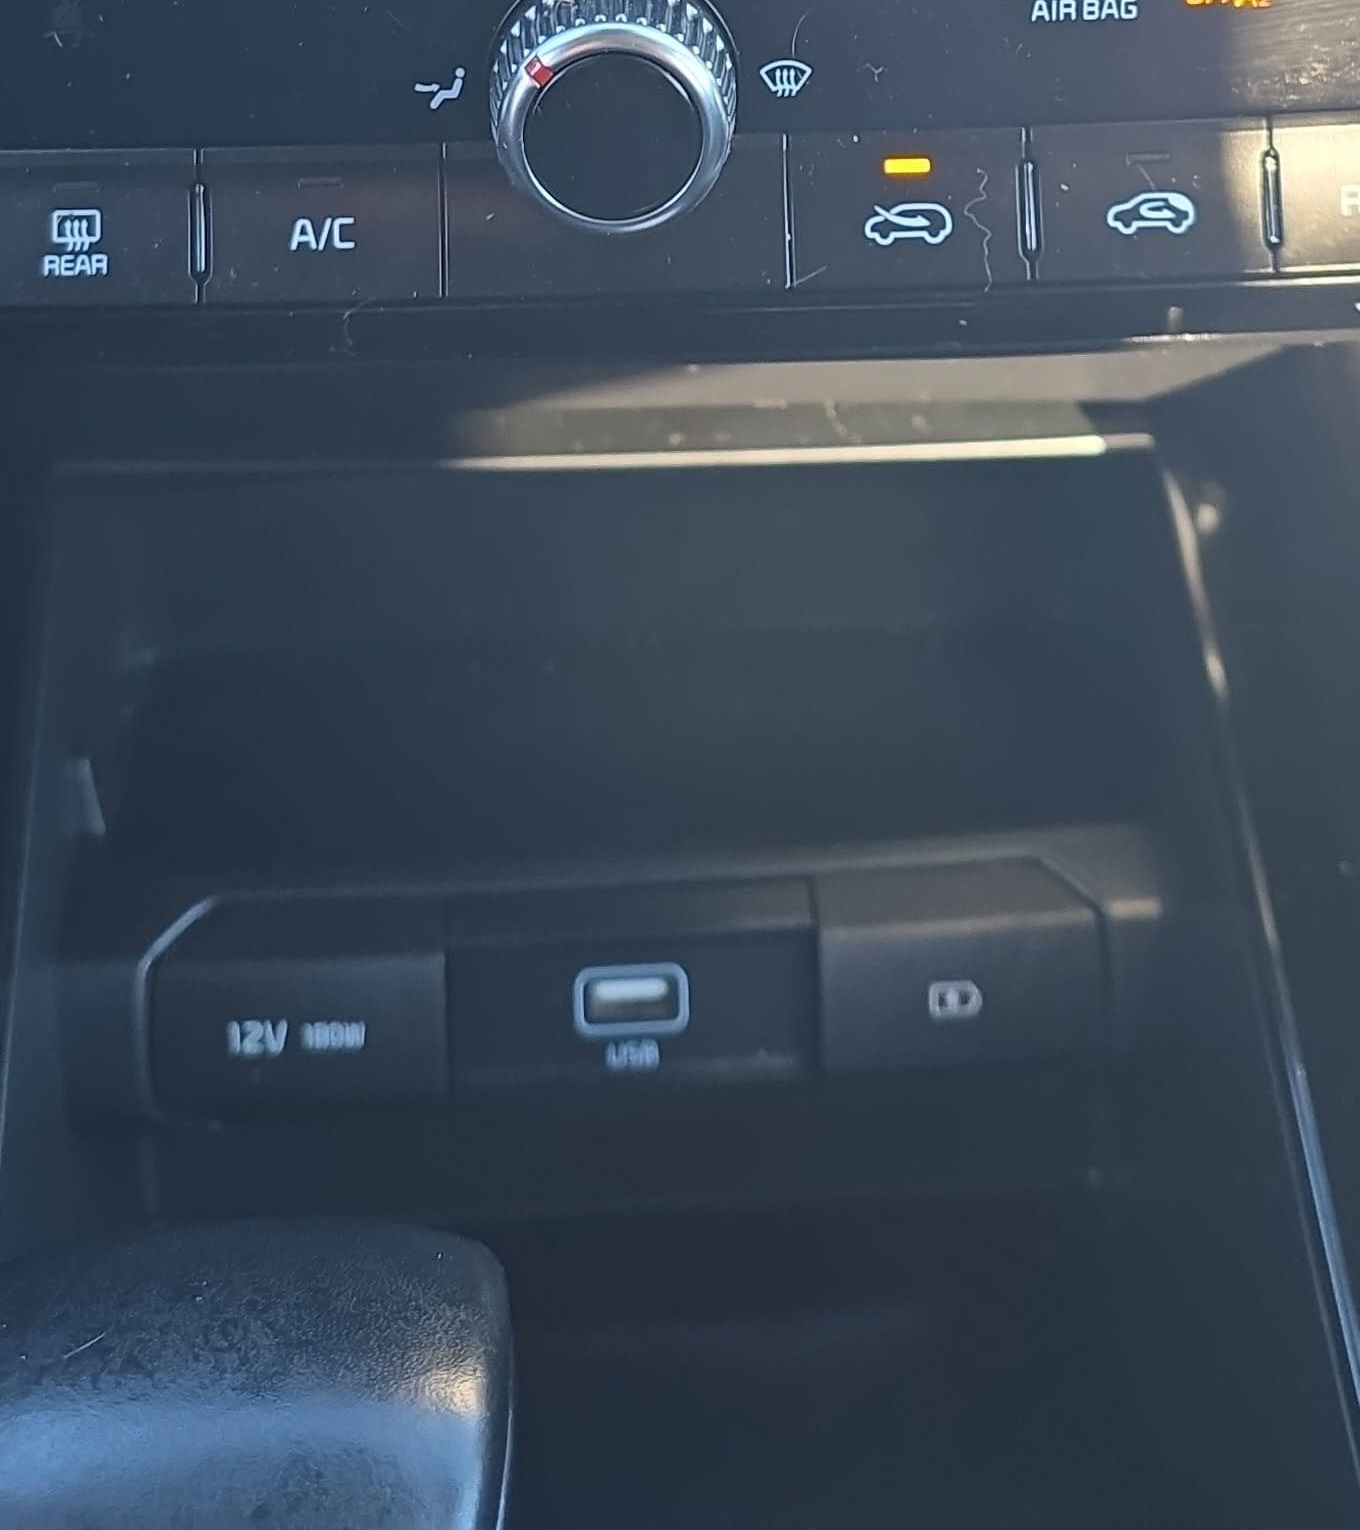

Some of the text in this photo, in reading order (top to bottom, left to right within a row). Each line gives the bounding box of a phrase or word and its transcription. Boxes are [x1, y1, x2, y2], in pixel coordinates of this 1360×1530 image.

[289, 217, 356, 251] A/C
[42, 254, 108, 277] REAR
[226, 1019, 288, 1055] 12V
